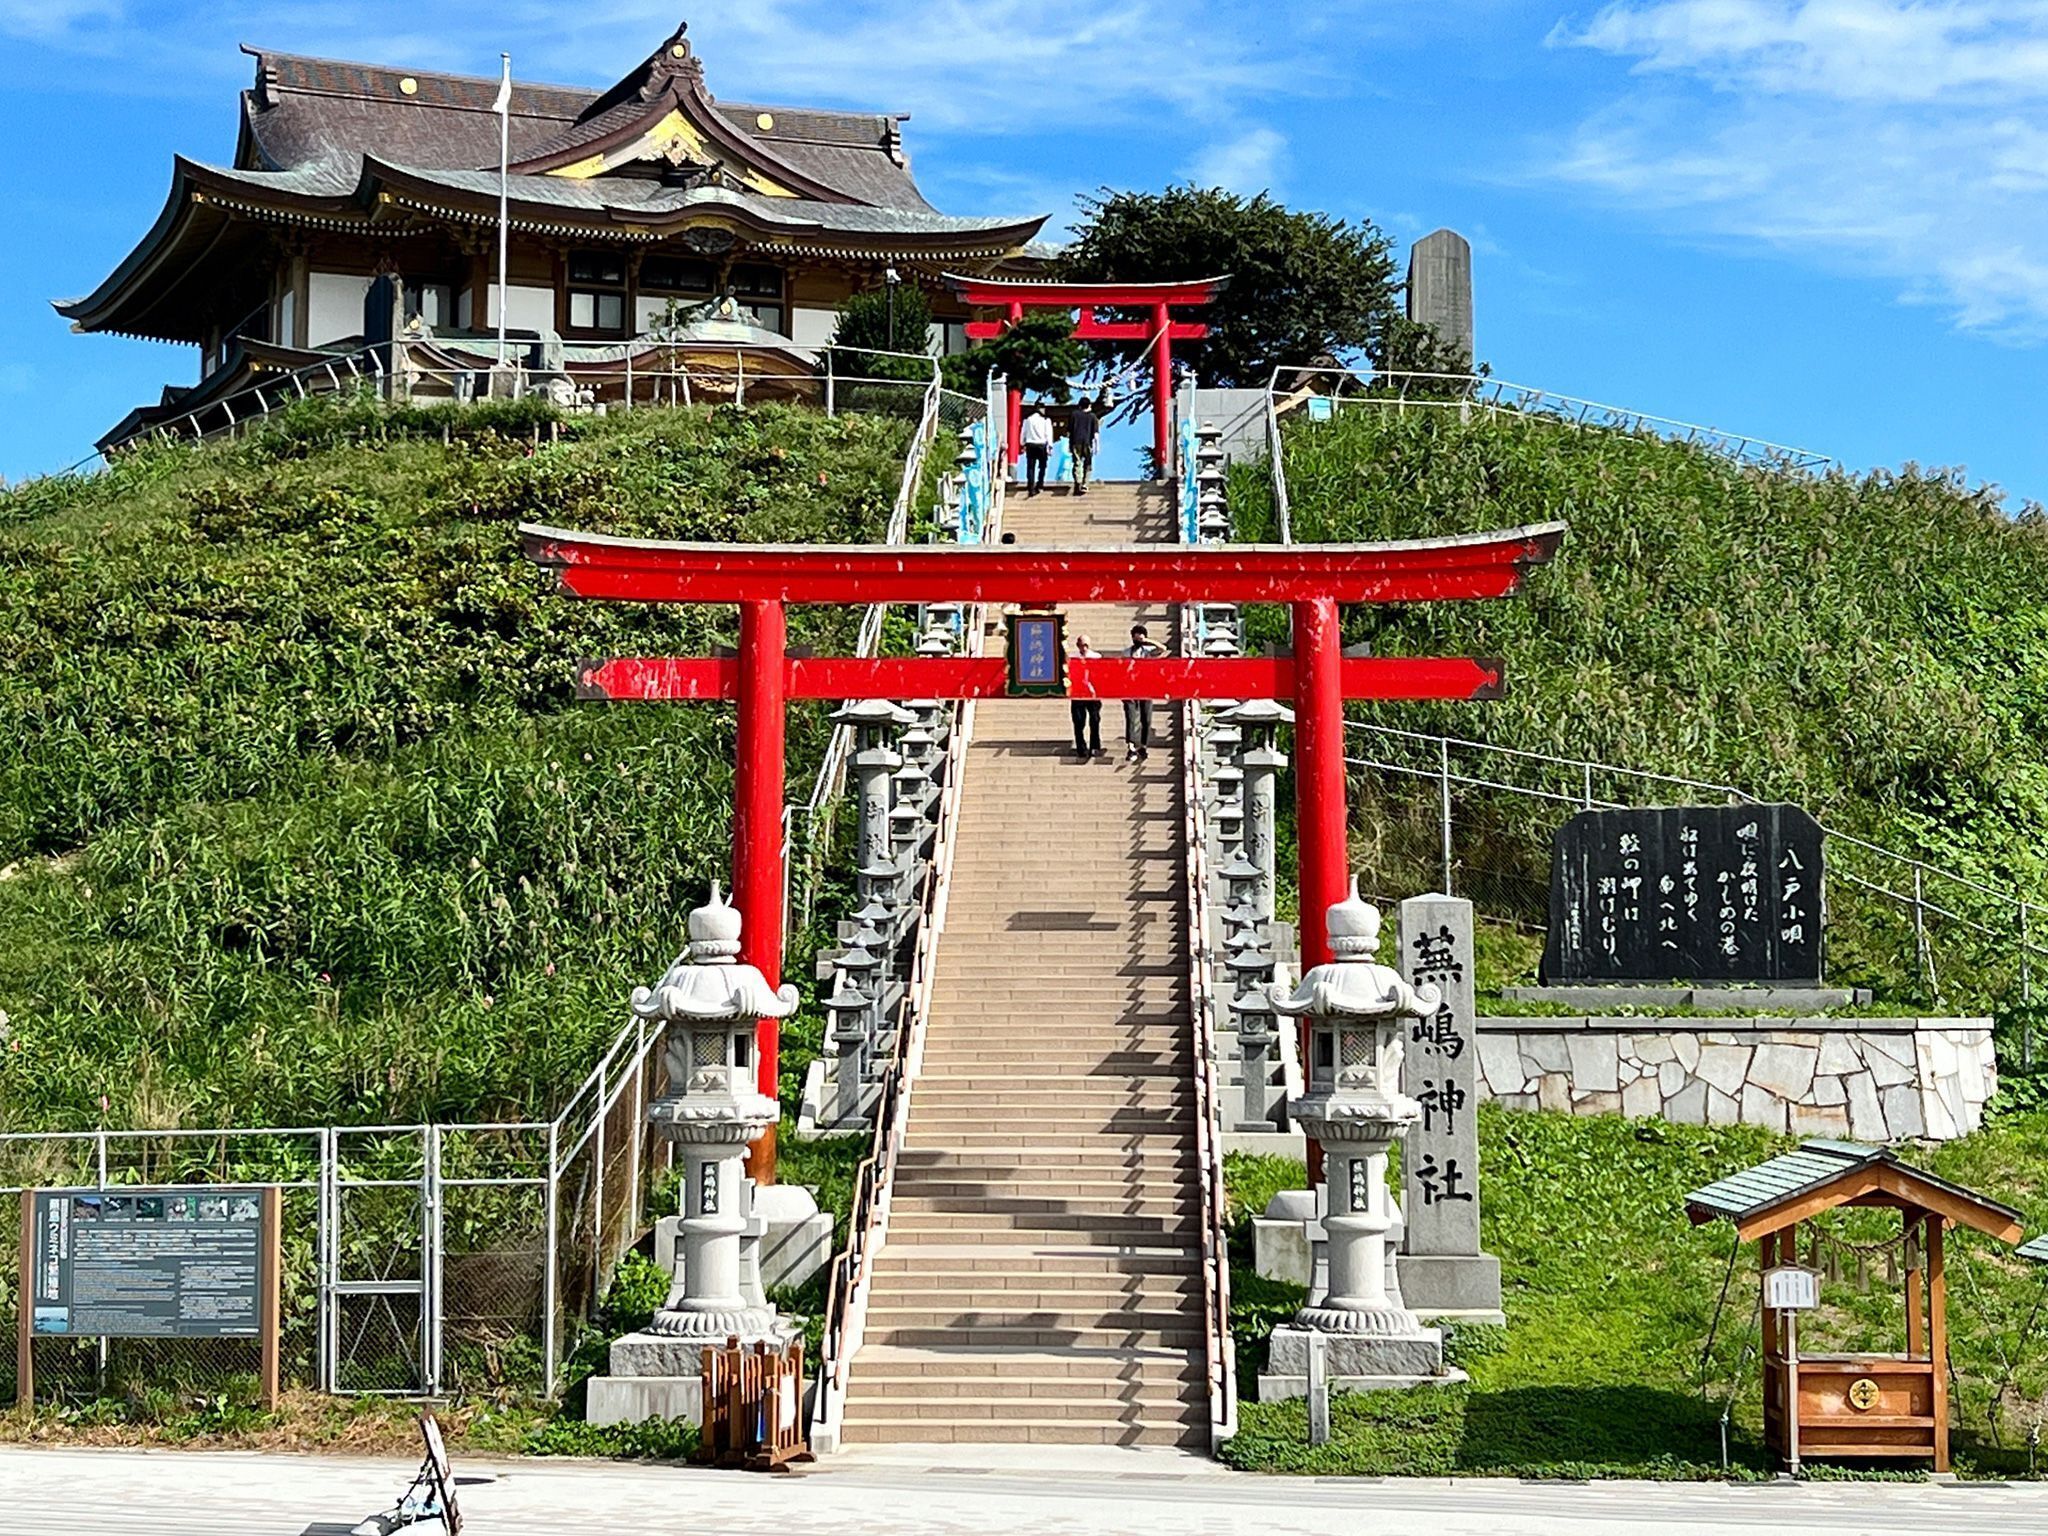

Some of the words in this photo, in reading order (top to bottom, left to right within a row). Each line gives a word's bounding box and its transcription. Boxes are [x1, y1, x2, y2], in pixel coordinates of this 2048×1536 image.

[1779, 848, 1806, 944] 八戸小唄
[1411, 924, 1473, 1206] 蕪嶋神社
